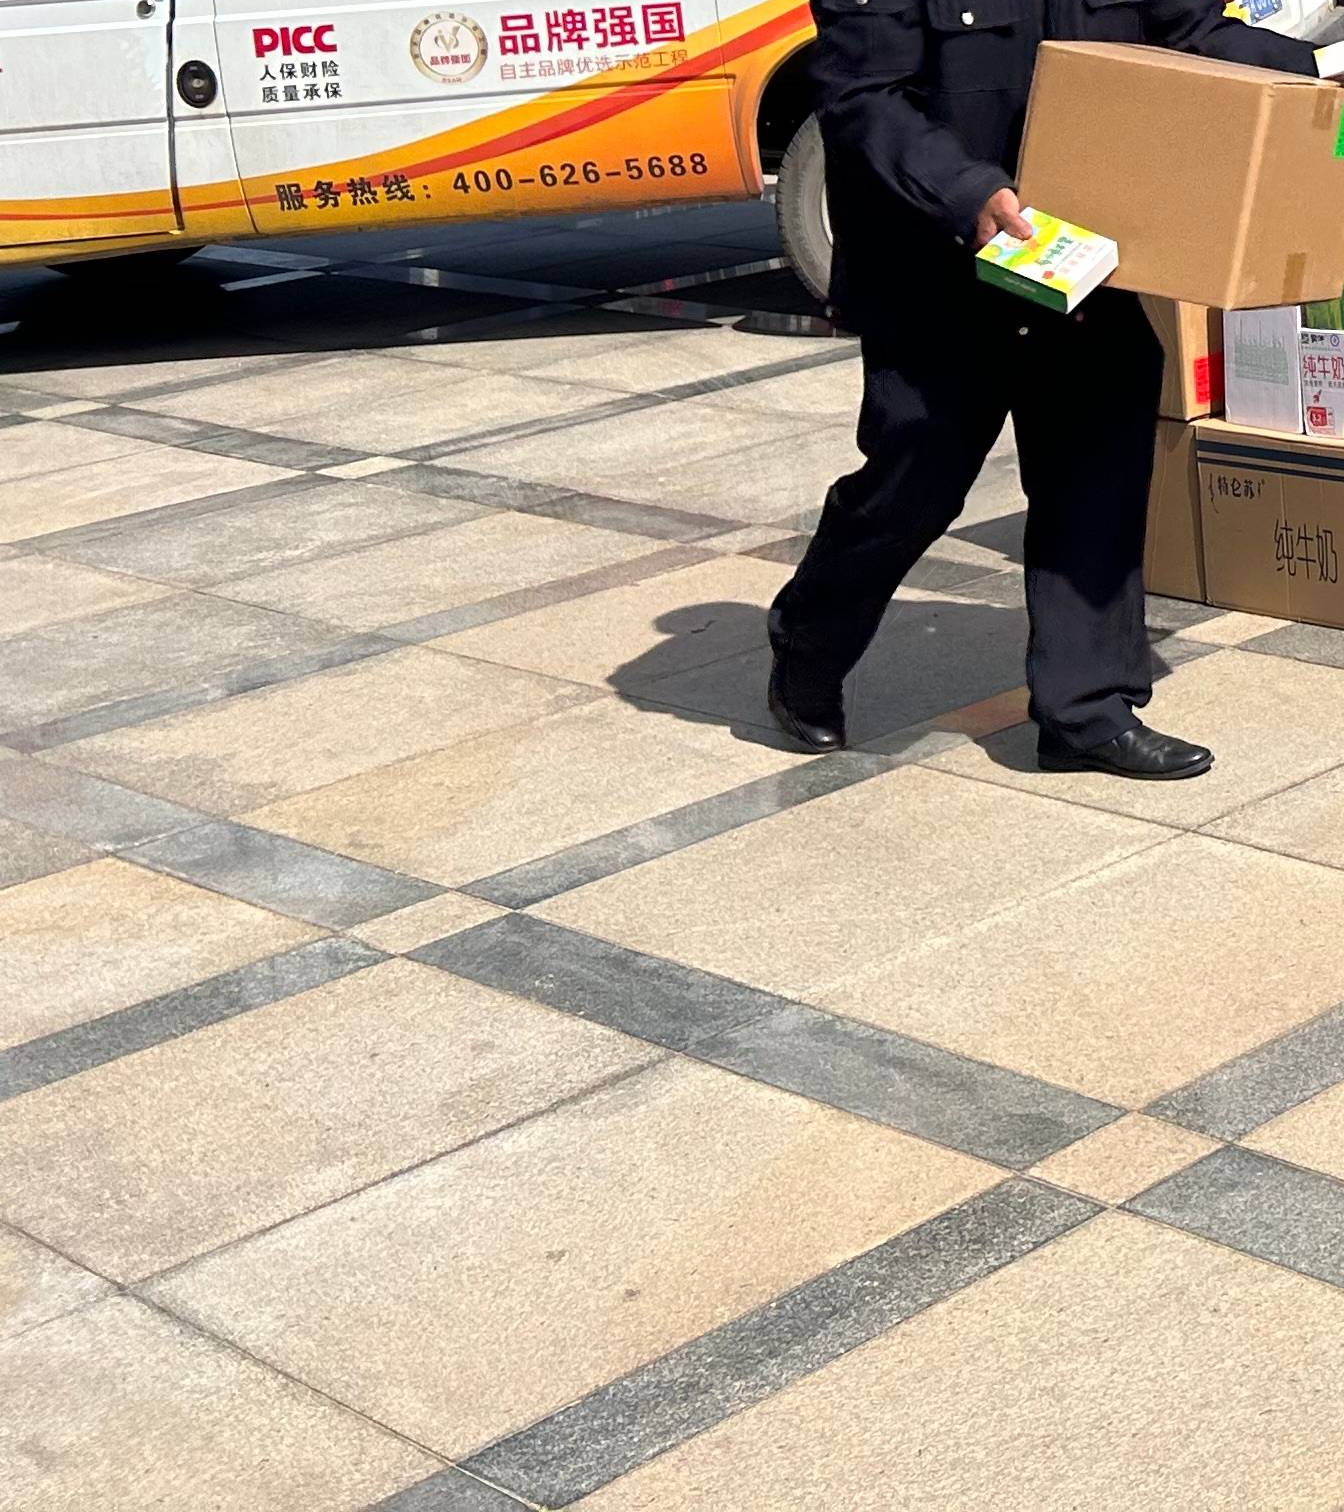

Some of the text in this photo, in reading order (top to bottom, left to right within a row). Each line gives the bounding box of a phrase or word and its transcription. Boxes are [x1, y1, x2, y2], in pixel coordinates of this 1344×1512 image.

[252, 24, 337, 57] PICC
[499, 2, 685, 56] 品牌强国
[260, 60, 340, 81] 人保财险
[500, 49, 688, 80] 自主品牌优选示范工程
[261, 82, 342, 104] 质量承保
[453, 152, 709, 195] 400-626-5688
[1273, 519, 1338, 583] 纯牛奶
